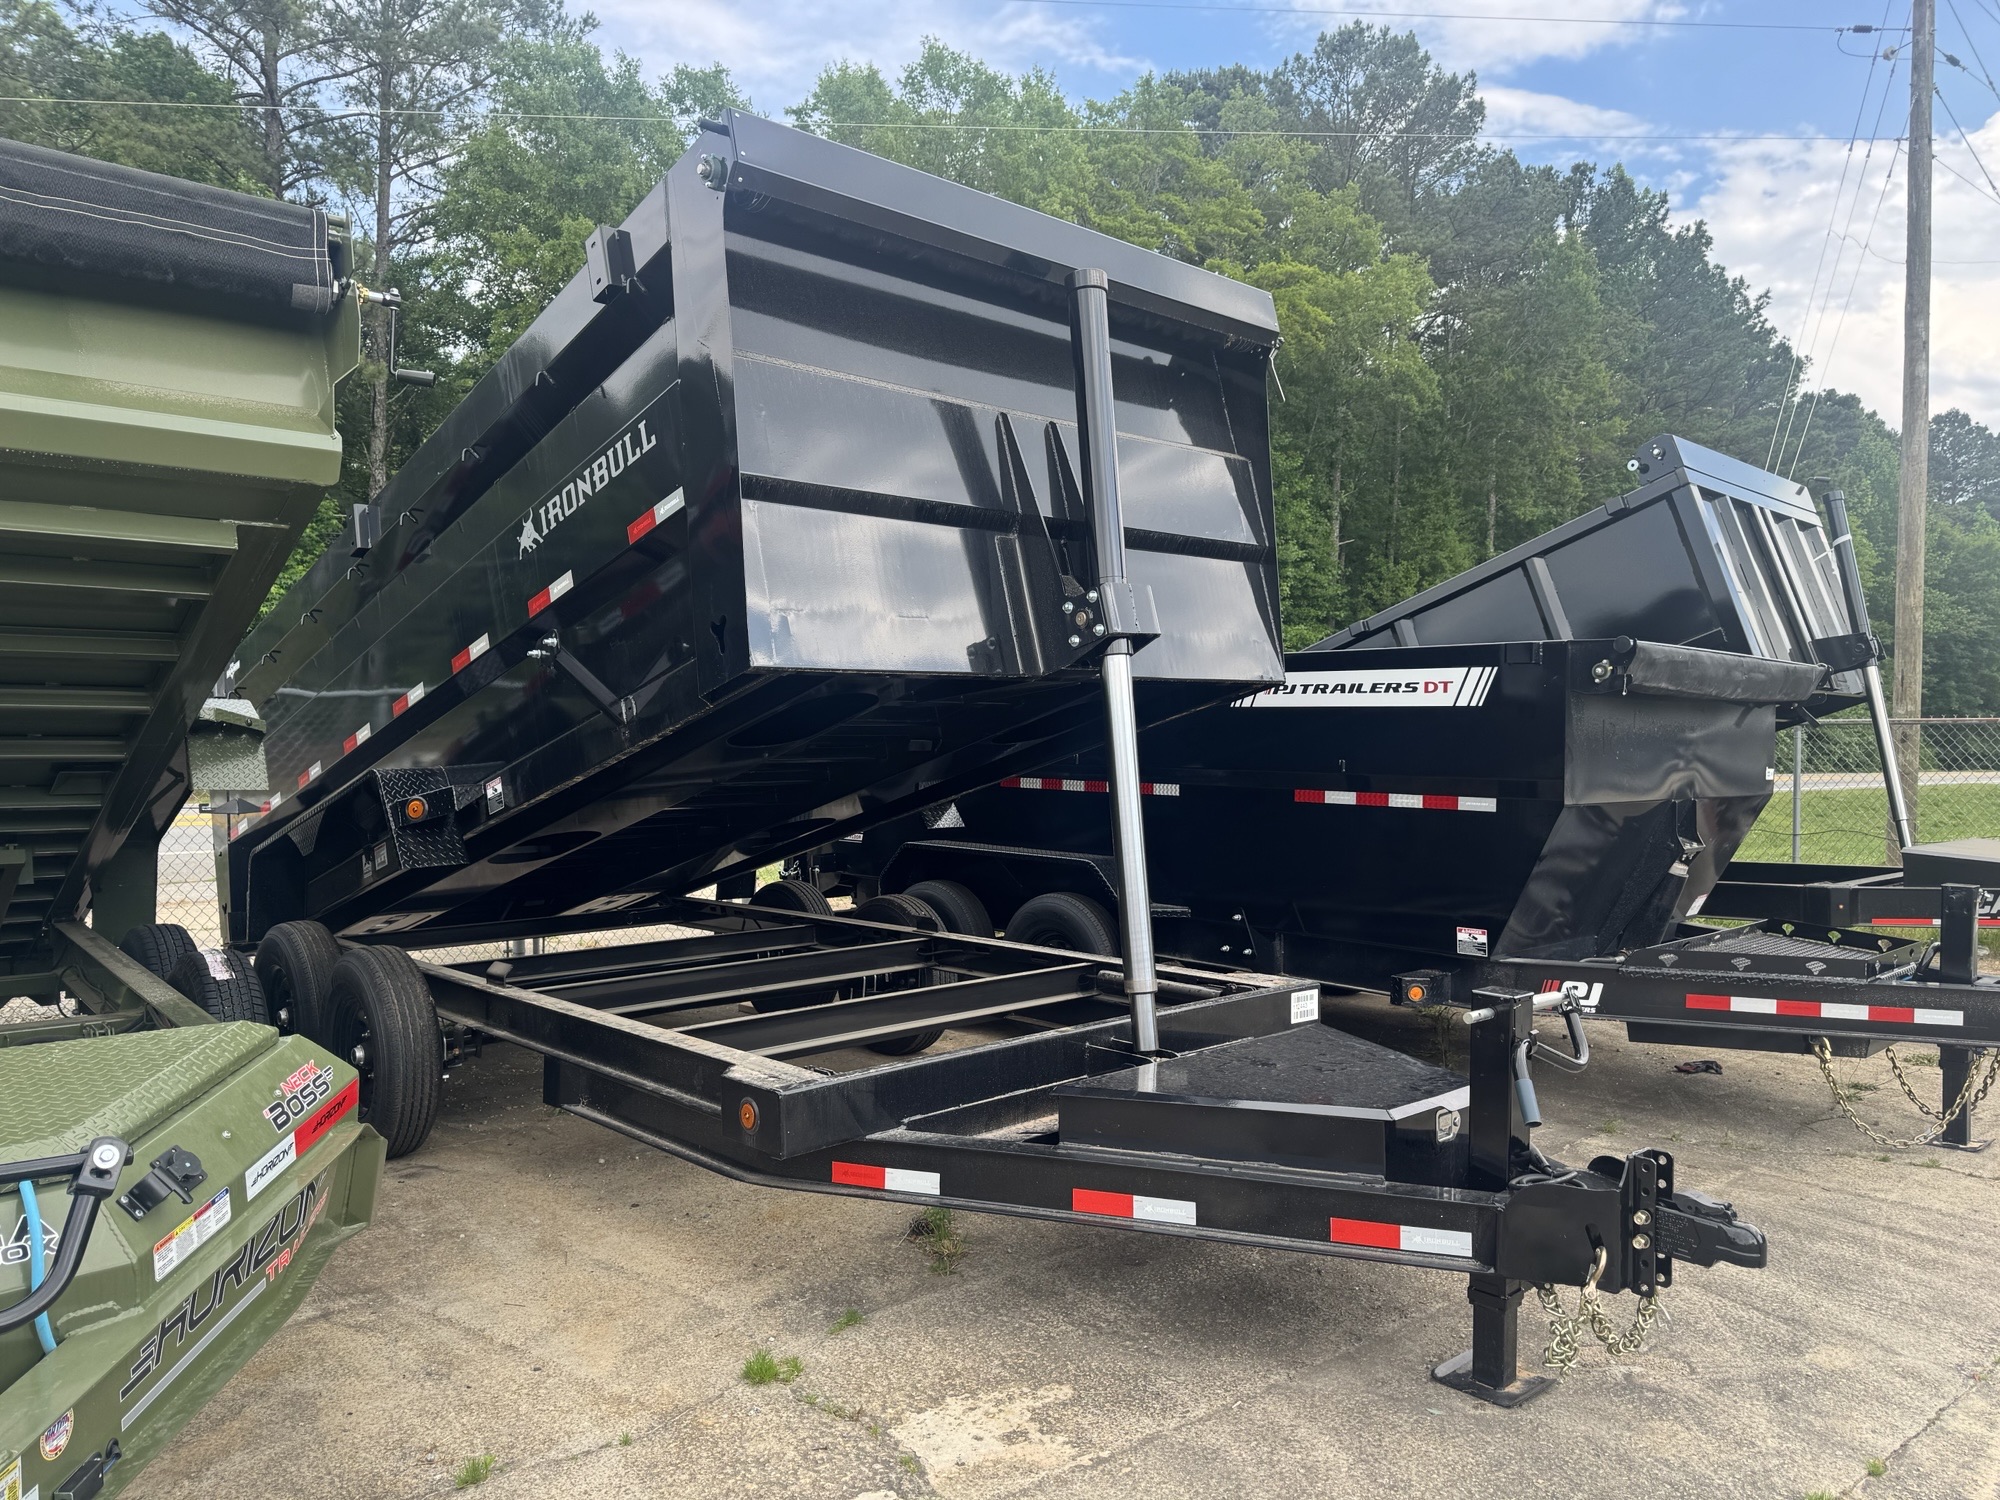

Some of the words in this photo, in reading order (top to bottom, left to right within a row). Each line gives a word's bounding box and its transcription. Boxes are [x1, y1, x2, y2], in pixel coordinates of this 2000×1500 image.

[539, 419, 657, 536] IRONBULL
[1300, 681, 1420, 694] TRAILERS
[1423, 680, 1454, 694] DT
[280, 1059, 320, 1096] NECK
[265, 1069, 332, 1133] BOSS
[312, 1095, 347, 1134] HORIZON
[251, 1142, 294, 1187] HORIZON
